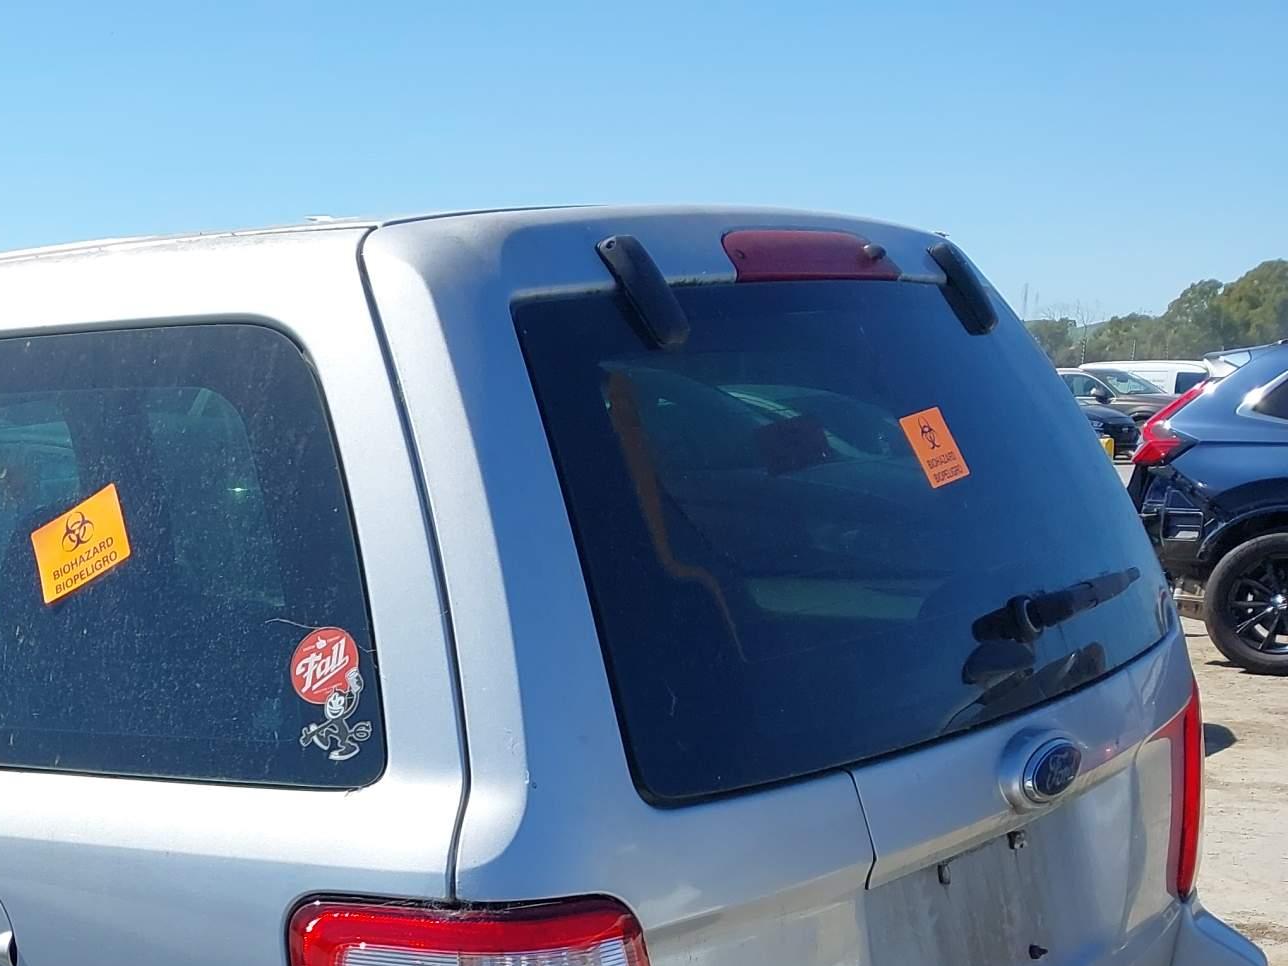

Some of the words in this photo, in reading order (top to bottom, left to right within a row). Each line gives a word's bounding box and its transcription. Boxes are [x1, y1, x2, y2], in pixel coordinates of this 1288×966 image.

[52, 536, 114, 580] BIOHAZARD
[55, 550, 118, 594] BIOPELIGRO
[295, 636, 350, 694] Fall
